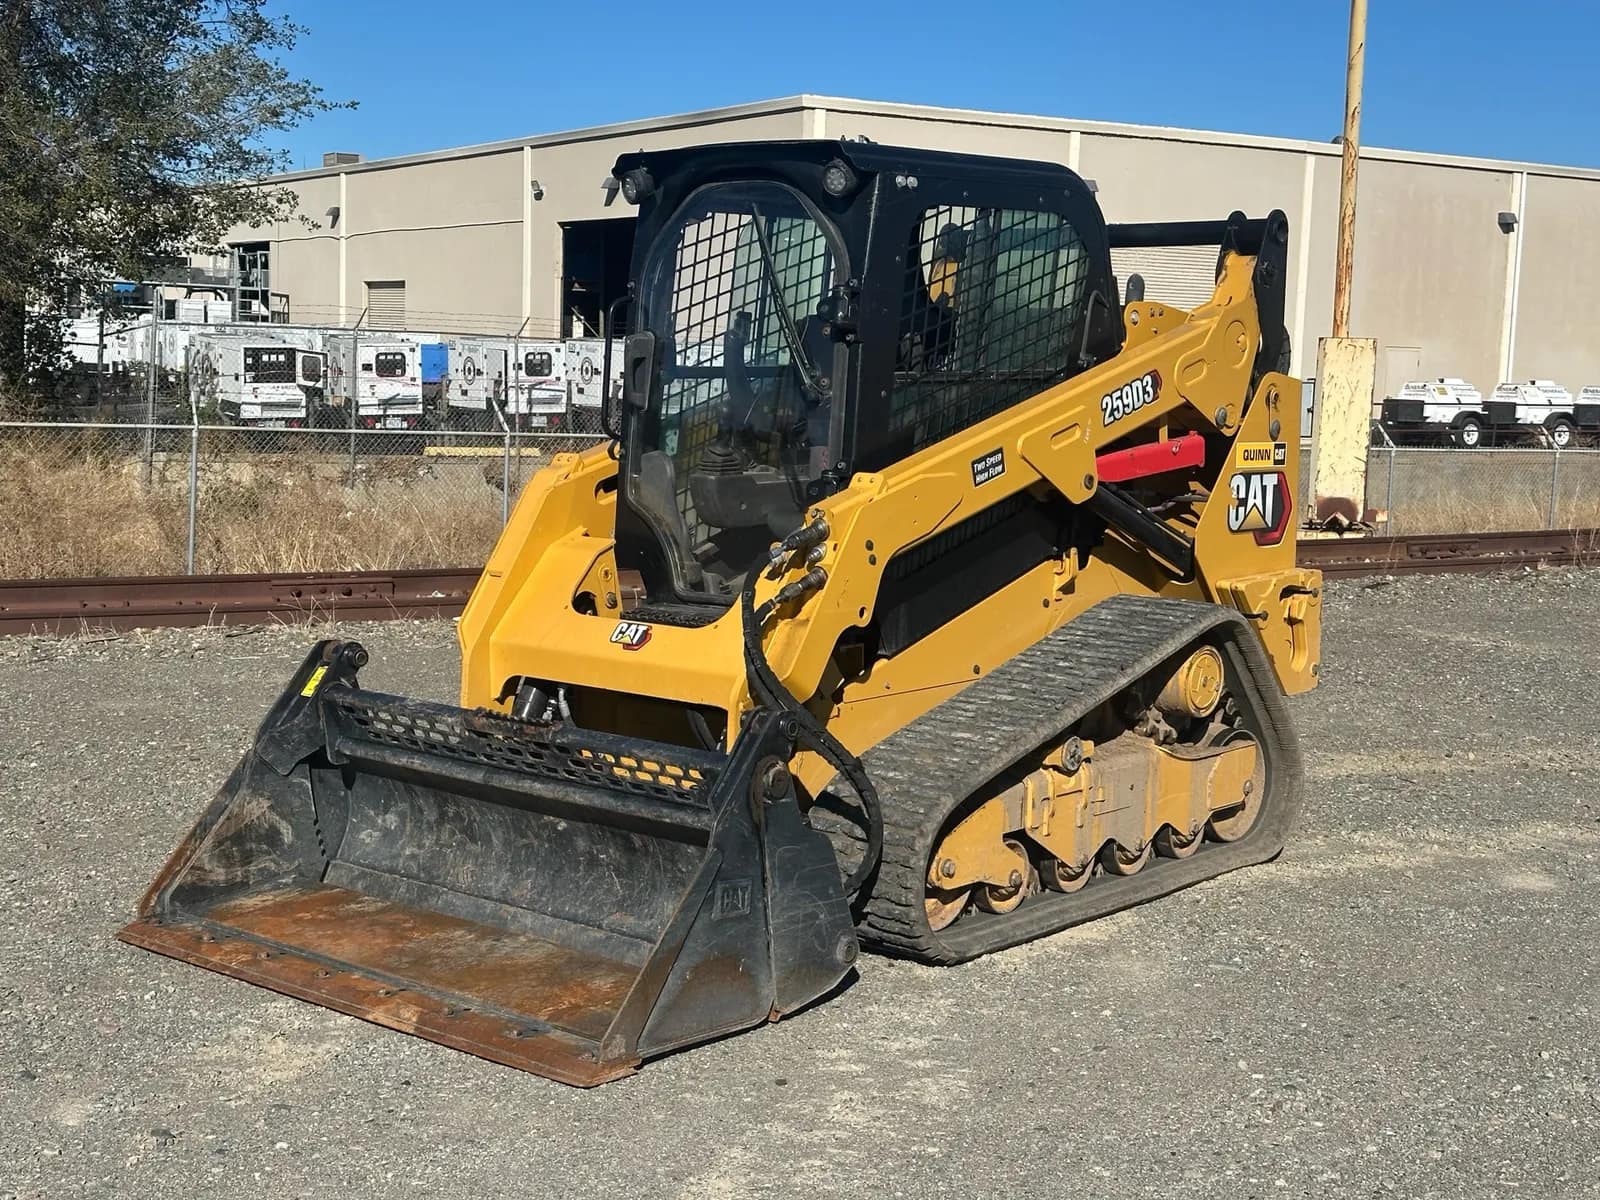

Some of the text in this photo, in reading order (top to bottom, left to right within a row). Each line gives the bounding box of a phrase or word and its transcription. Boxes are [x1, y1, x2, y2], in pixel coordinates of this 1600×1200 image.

[1102, 374, 1154, 426] 259D3
[1243, 449, 1271, 461] QUINN
[1229, 473, 1278, 531] CAT
[610, 622, 649, 645] CAT
